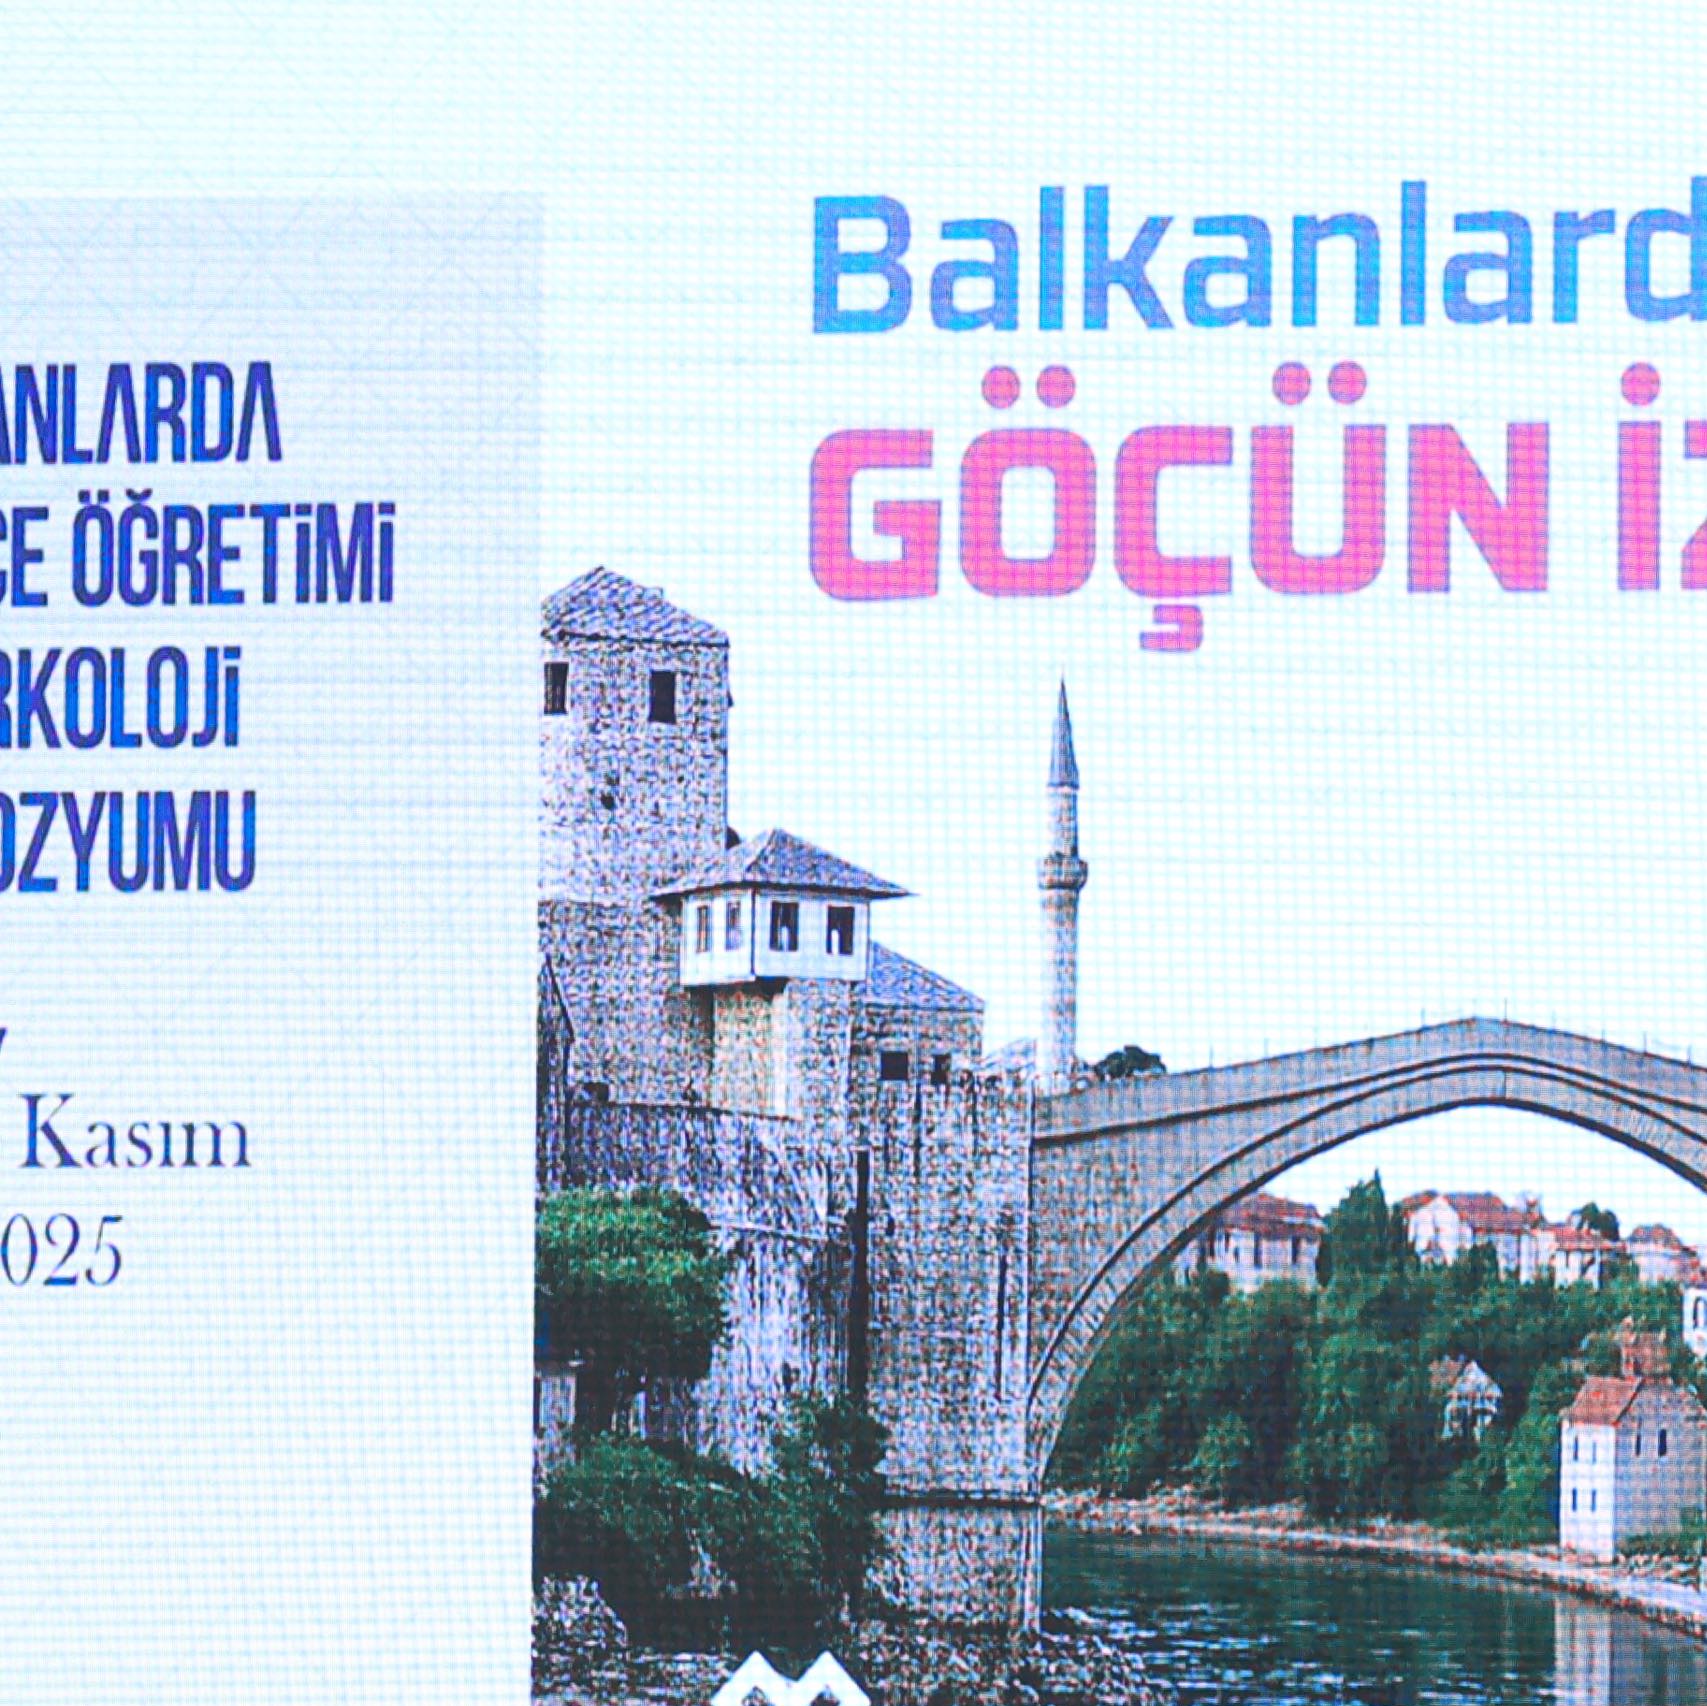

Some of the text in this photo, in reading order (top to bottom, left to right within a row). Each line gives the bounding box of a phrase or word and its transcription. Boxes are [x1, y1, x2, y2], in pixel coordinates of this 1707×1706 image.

[0, 361, 282, 465] NLARDA
[0, 488, 395, 609] E ÖĞRETİMİ
[808, 361, 1551, 653] GÖÇÜN
[0, 645, 242, 750] KOLOJİ
[18, 1091, 252, 1168] Kasım
